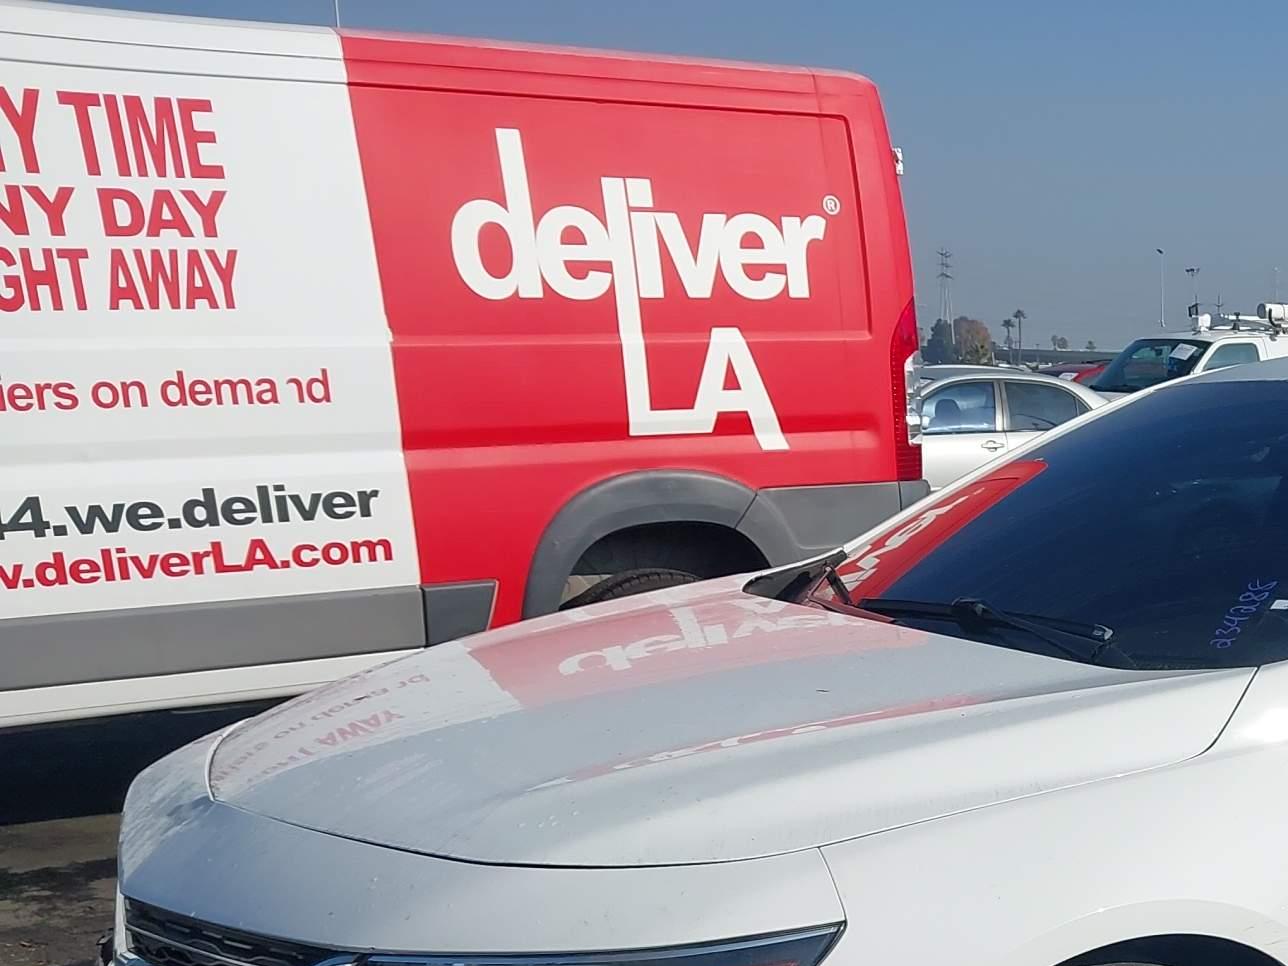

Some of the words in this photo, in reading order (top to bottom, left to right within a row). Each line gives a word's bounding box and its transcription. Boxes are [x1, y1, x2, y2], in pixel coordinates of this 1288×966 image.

[56, 90, 226, 179] TIME
[96, 187, 228, 238] DAY
[109, 248, 238, 310] AWAY
[91, 380, 149, 408] on
[608, 298, 790, 451] LA
[0, 484, 380, 540] 4.we.deliver
